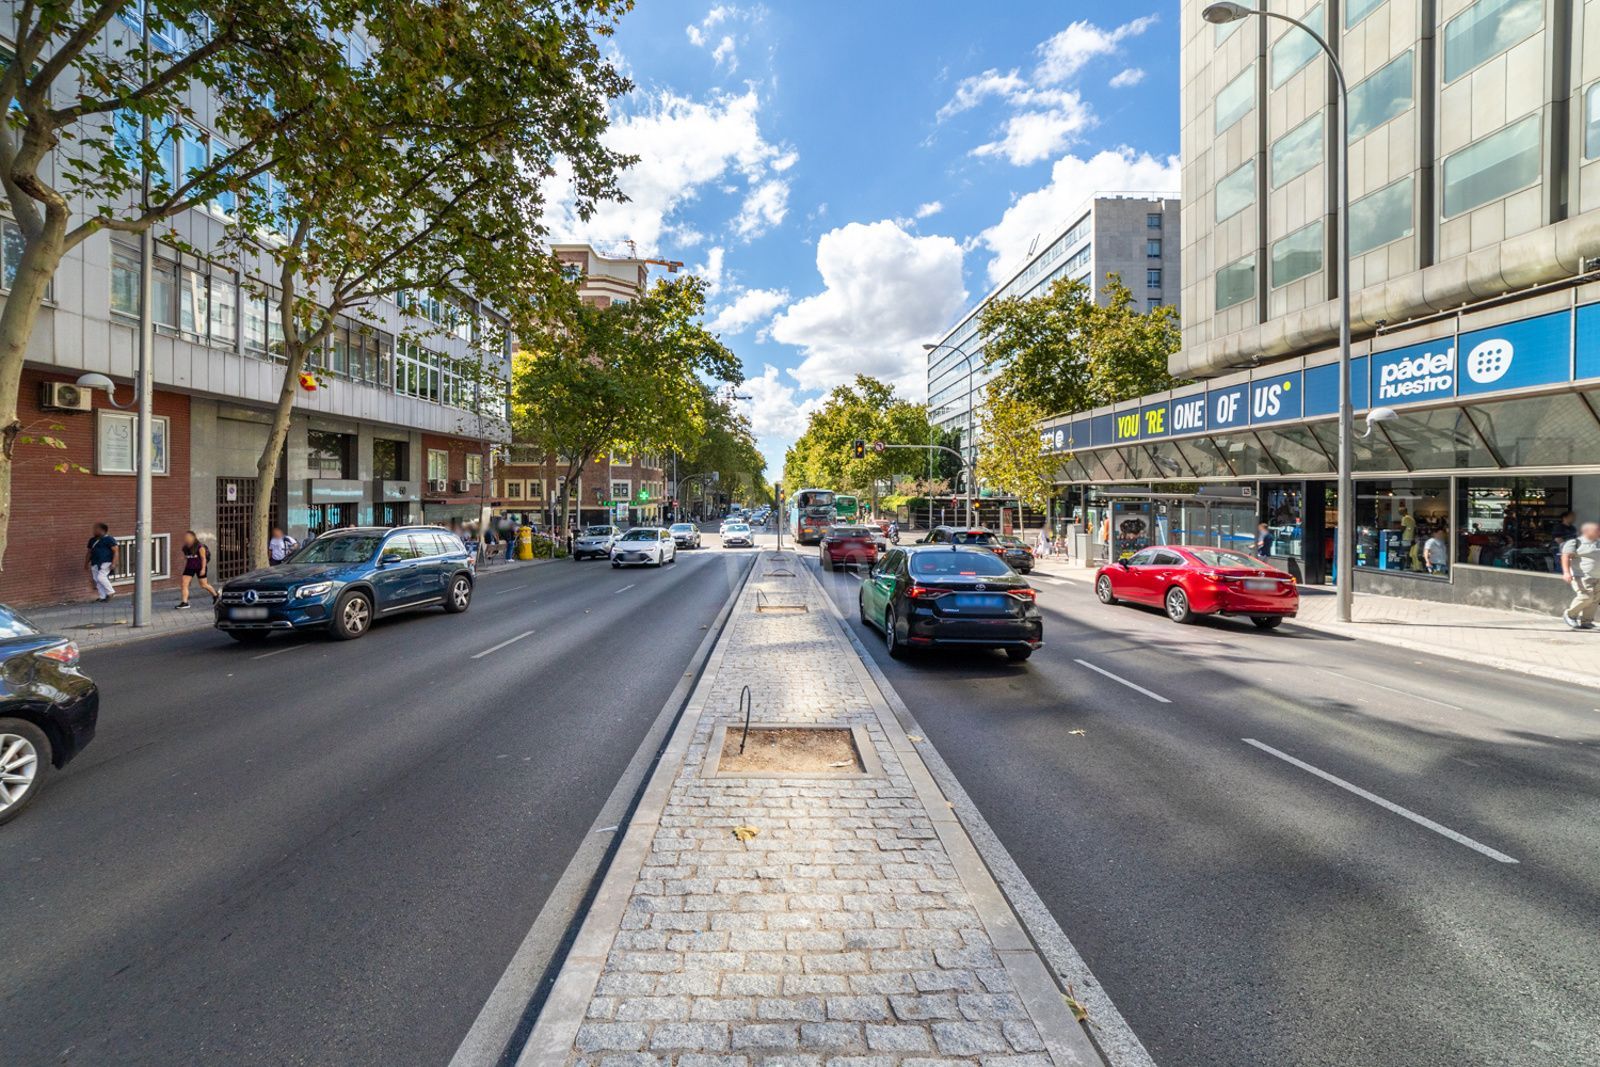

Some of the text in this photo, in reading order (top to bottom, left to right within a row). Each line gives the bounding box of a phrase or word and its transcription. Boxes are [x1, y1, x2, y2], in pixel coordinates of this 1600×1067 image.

[1380, 347, 1455, 386] pádel
[1379, 374, 1453, 399] nuestro
[1117, 412, 1140, 439] YOU
[1174, 399, 1205, 430] ONE
[1216, 391, 1241, 424] OF
[1253, 383, 1282, 418] US
